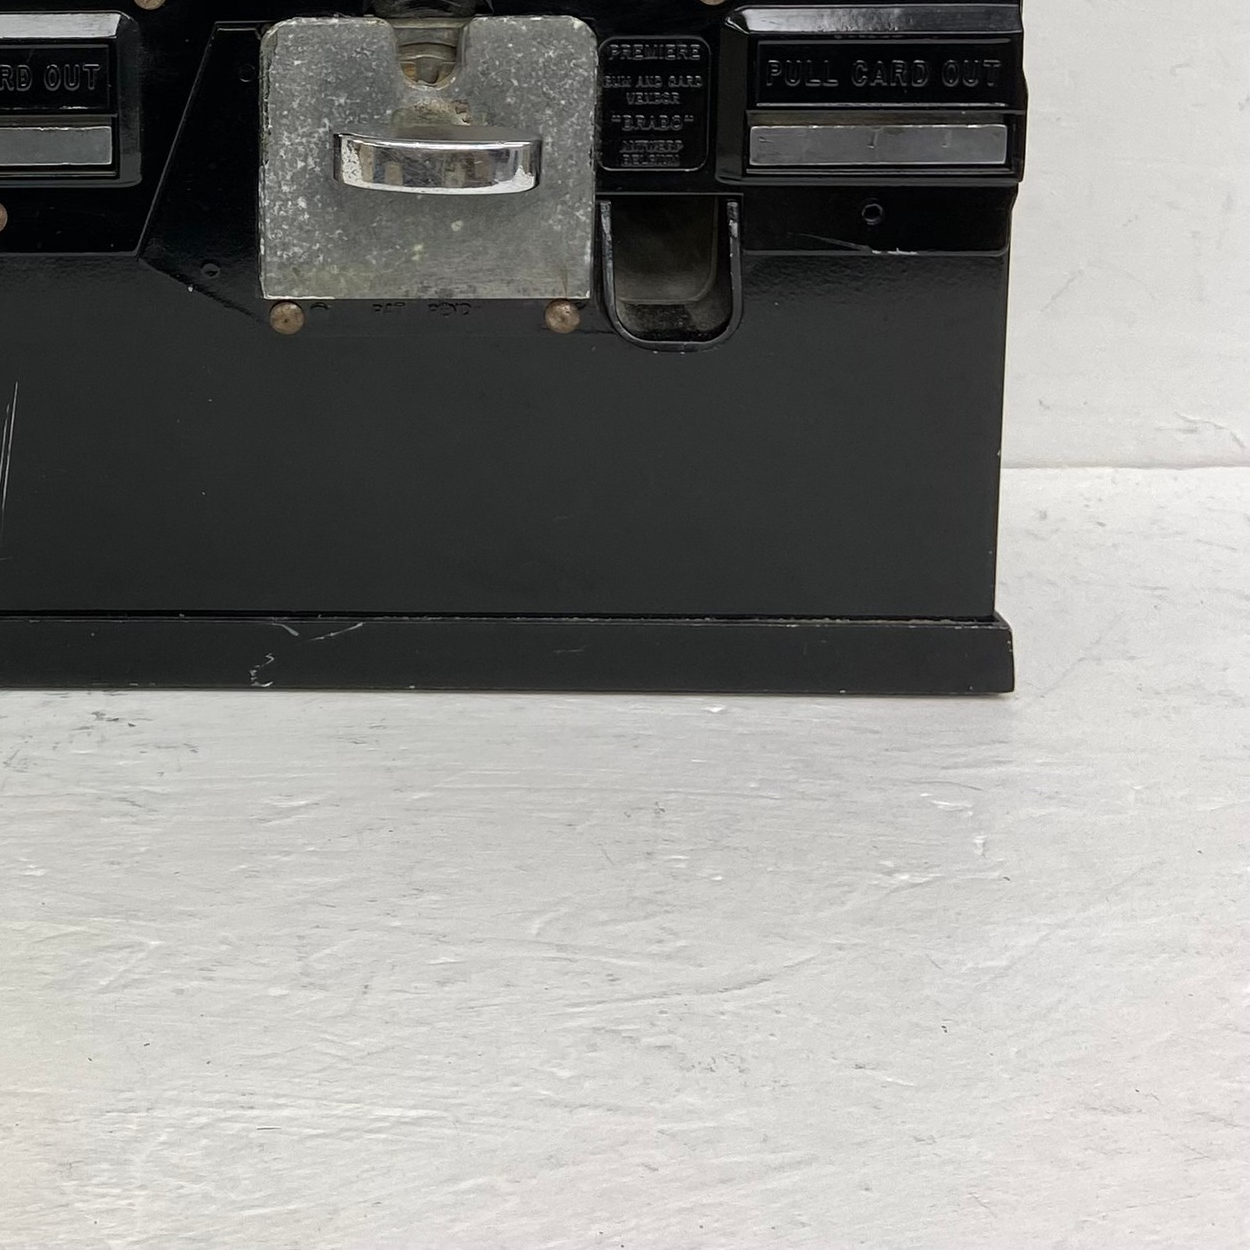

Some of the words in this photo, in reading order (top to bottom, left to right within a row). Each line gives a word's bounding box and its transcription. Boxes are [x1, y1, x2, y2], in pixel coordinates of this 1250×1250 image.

[43, 63, 101, 92] OUT
[765, 59, 839, 87] PULL
[851, 59, 930, 88] CARD
[941, 59, 1001, 87] OUT
